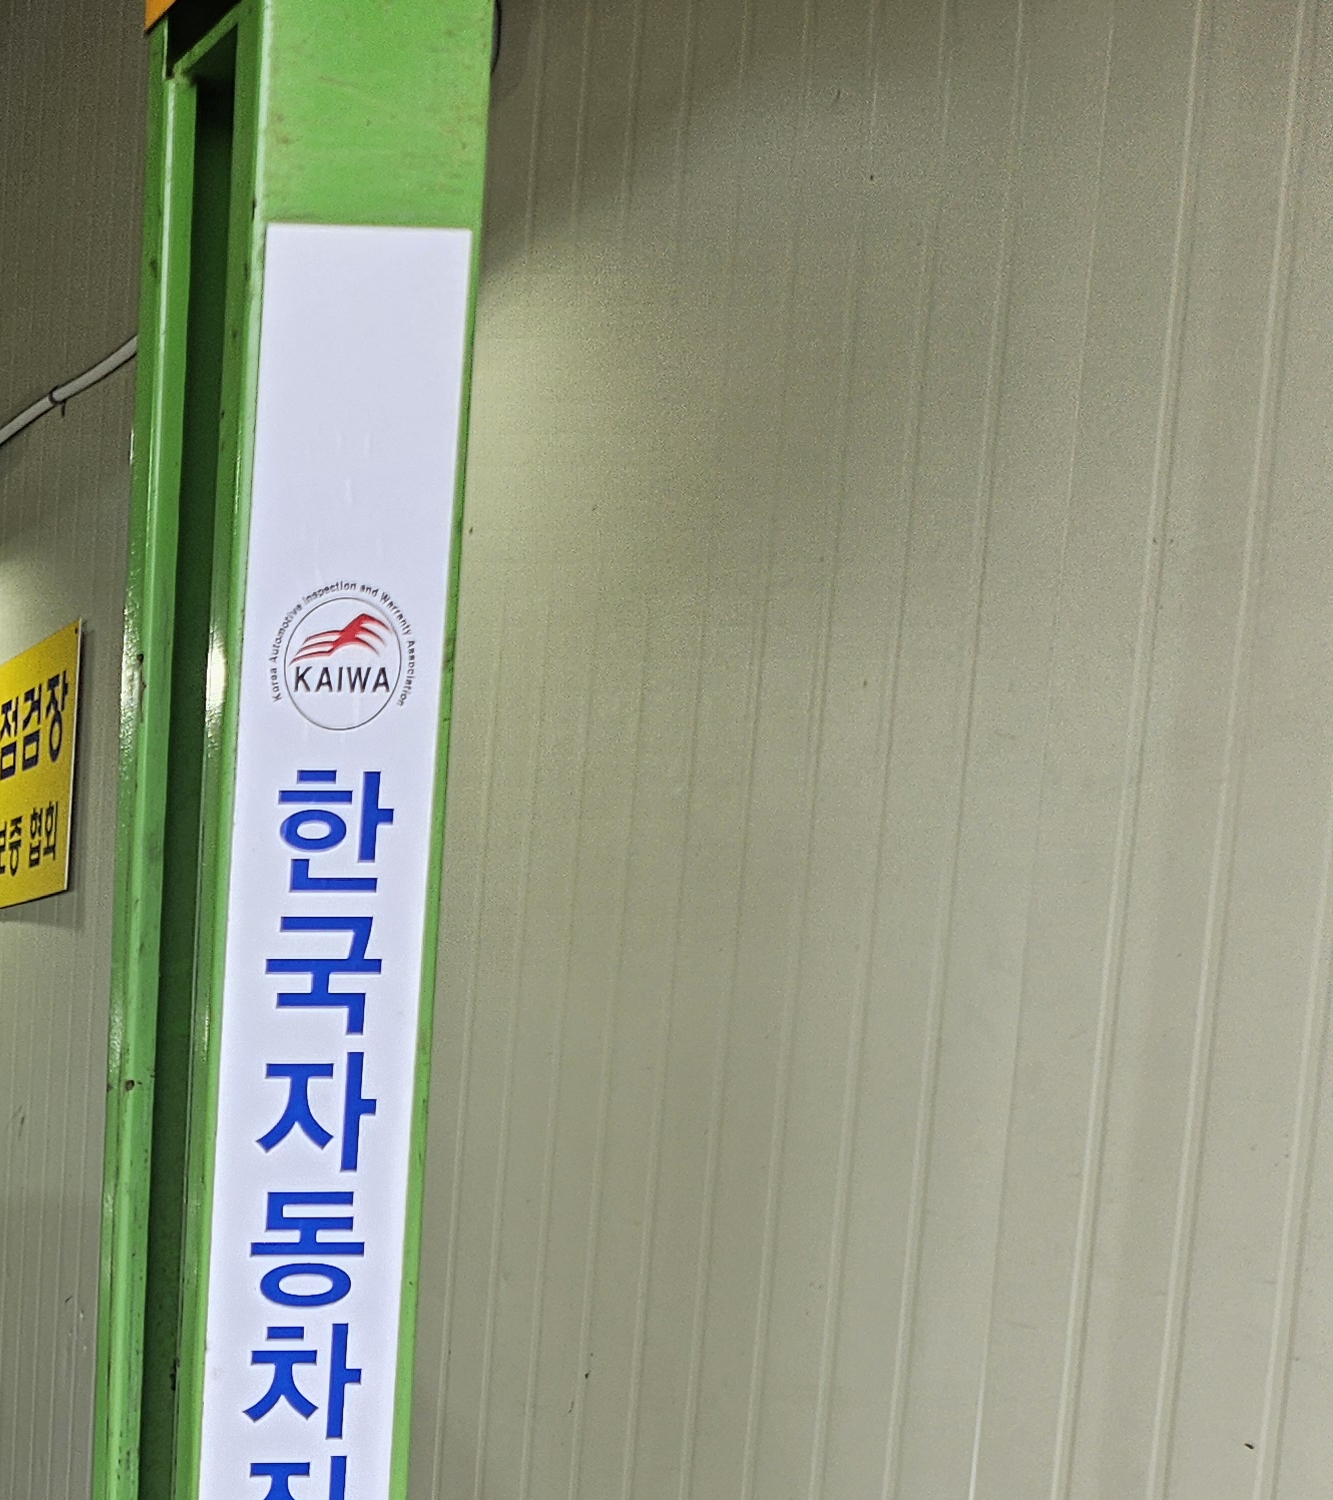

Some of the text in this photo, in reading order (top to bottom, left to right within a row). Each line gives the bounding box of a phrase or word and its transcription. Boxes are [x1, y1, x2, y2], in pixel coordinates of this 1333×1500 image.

[360, 584, 379, 598] and
[379, 591, 413, 636] Warranty
[269, 603, 303, 664] Automotive
[268, 668, 282, 703] Korea
[294, 666, 390, 693] KAIWA
[396, 640, 416, 707] Association
[0, 670, 68, 781] 점검장
[28, 801, 58, 868] 협회
